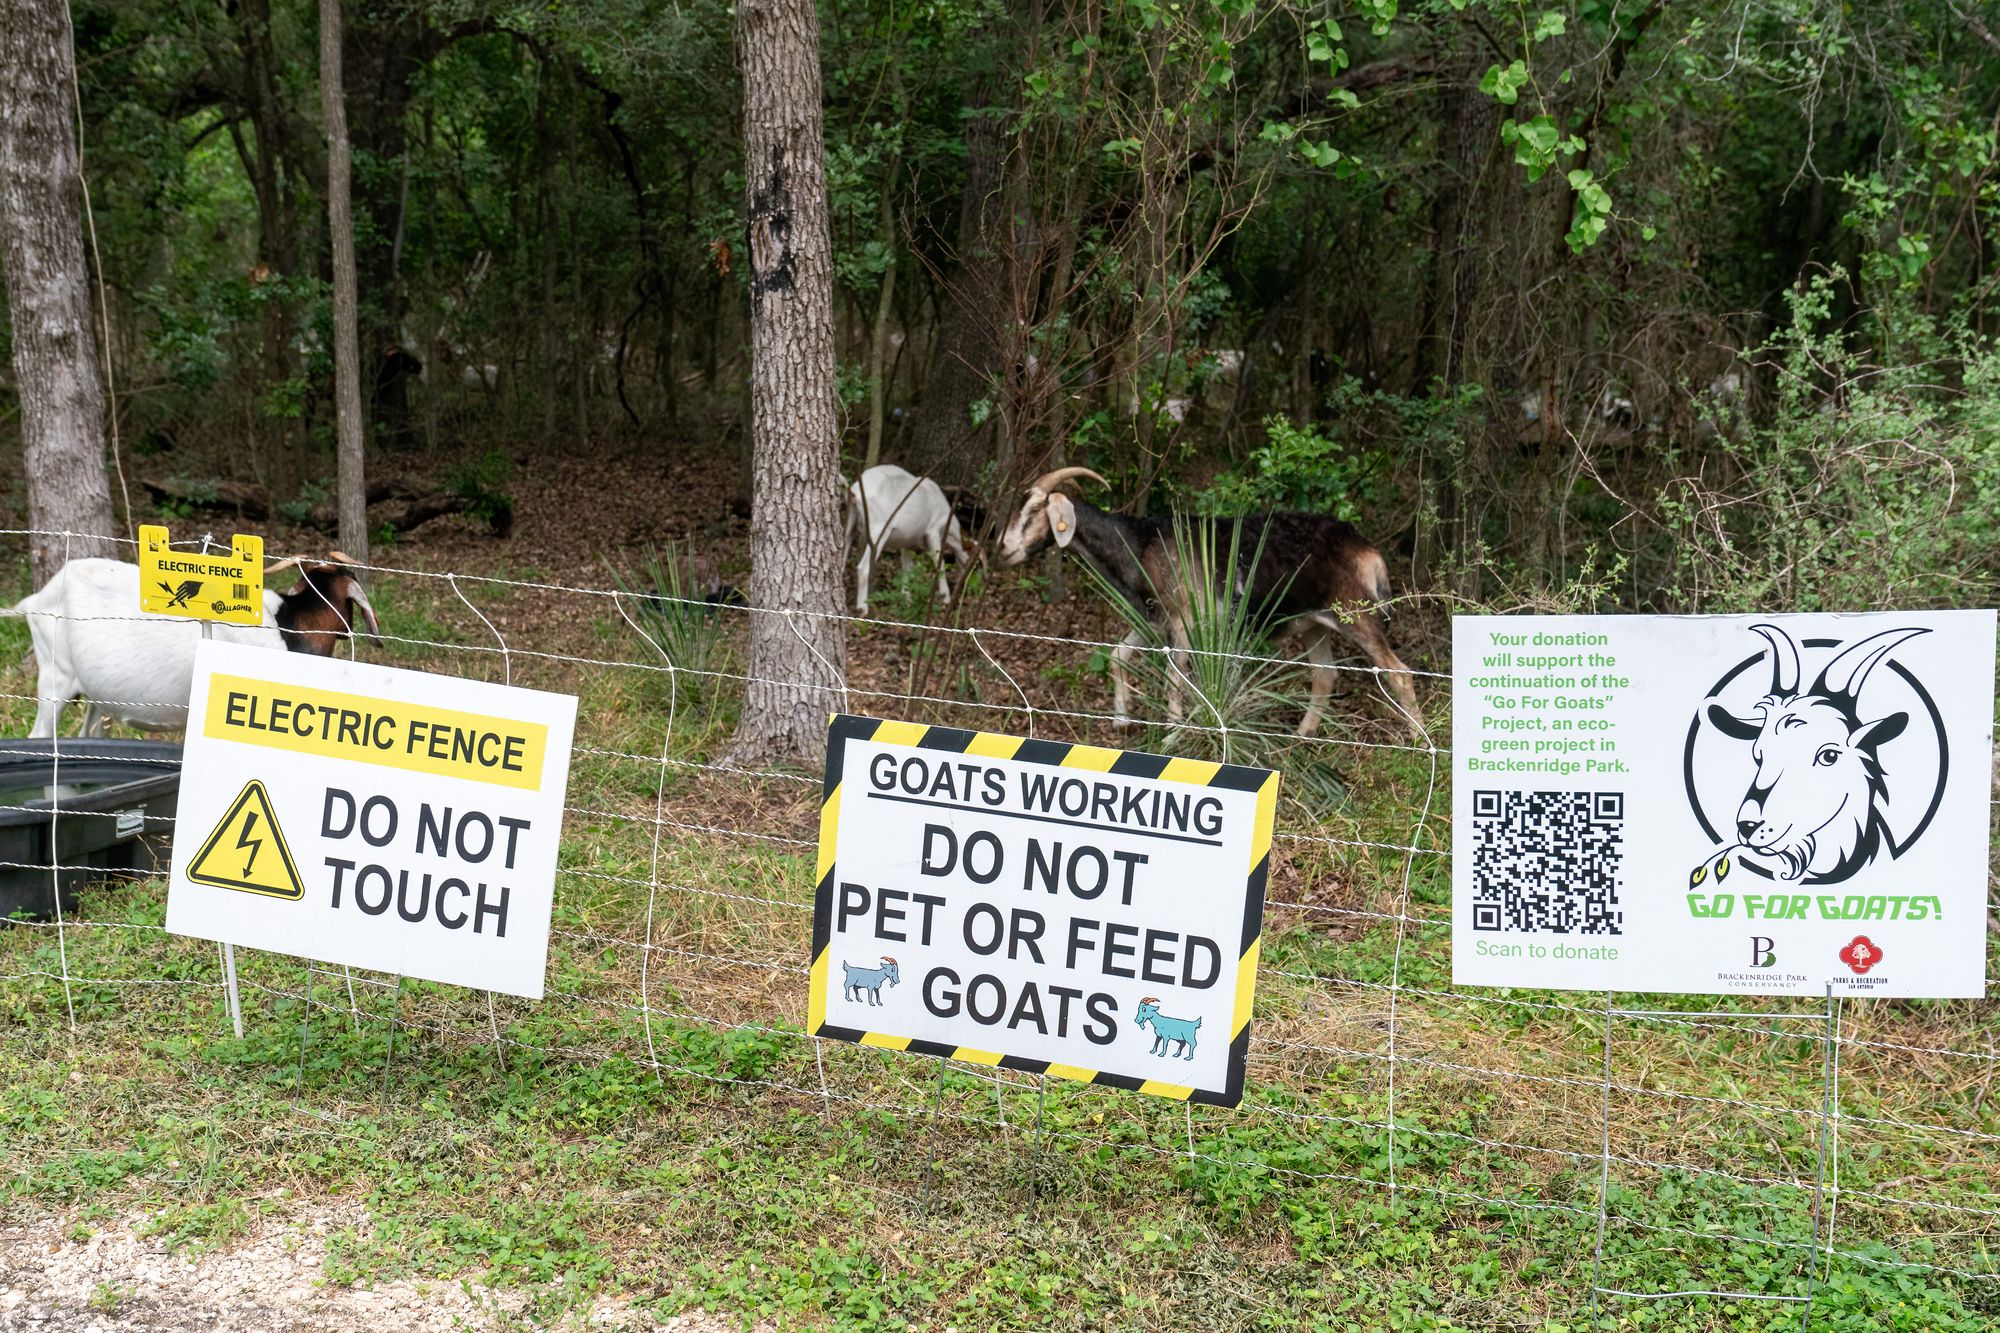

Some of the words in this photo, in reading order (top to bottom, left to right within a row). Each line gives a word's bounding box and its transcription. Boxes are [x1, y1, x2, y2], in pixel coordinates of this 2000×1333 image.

[158, 560, 205, 574] ELECTRIC
[209, 566, 242, 578] FENCE
[216, 603, 252, 613] GALLAGHER
[1490, 632, 1527, 646] Your
[1532, 632, 1608, 646] donation
[1483, 653, 1511, 667] will
[1516, 654, 1583, 670] support
[1588, 653, 1616, 667] the
[1469, 674, 1576, 688] continuation
[1581, 674, 1597, 688] of
[1602, 674, 1629, 688] the
[1484, 695, 1516, 709] “Go
[1521, 696, 1549, 709] For
[1554, 695, 1613, 709] Goats”
[226, 692, 396, 750] ELECTRIC
[406, 720, 526, 772] FENCE
[1482, 716, 1547, 733] Project,
[1552, 719, 1572, 730] an
[1578, 719, 1615, 730] eco-
[1482, 739, 1529, 753] green
[1535, 738, 1596, 754] project
[1600, 738, 1615, 751] in
[1468, 758, 1581, 775] Brackenridge
[1586, 759, 1629, 773] Park.
[870, 753, 1006, 805] GOATS
[1021, 772, 1223, 836] WORKING
[321, 787, 398, 847] DO
[416, 803, 531, 869] NOT
[921, 823, 1004, 884] DO
[1023, 838, 1149, 905] NOT
[324, 857, 510, 938] TOUCH
[1686, 894, 1735, 918] GO
[1743, 895, 1811, 920] FOR
[1816, 895, 1942, 920] GOATS!
[837, 882, 946, 946] PET
[963, 902, 1045, 964] OR
[1066, 917, 1222, 989] FEED
[1476, 940, 1522, 958] Scan
[1529, 943, 1547, 958] to
[1553, 943, 1618, 960] donate
[1718, 973, 1782, 981] BRACKENRIDGE
[1786, 974, 1808, 982] PARK
[922, 967, 1118, 1045] GOATS
